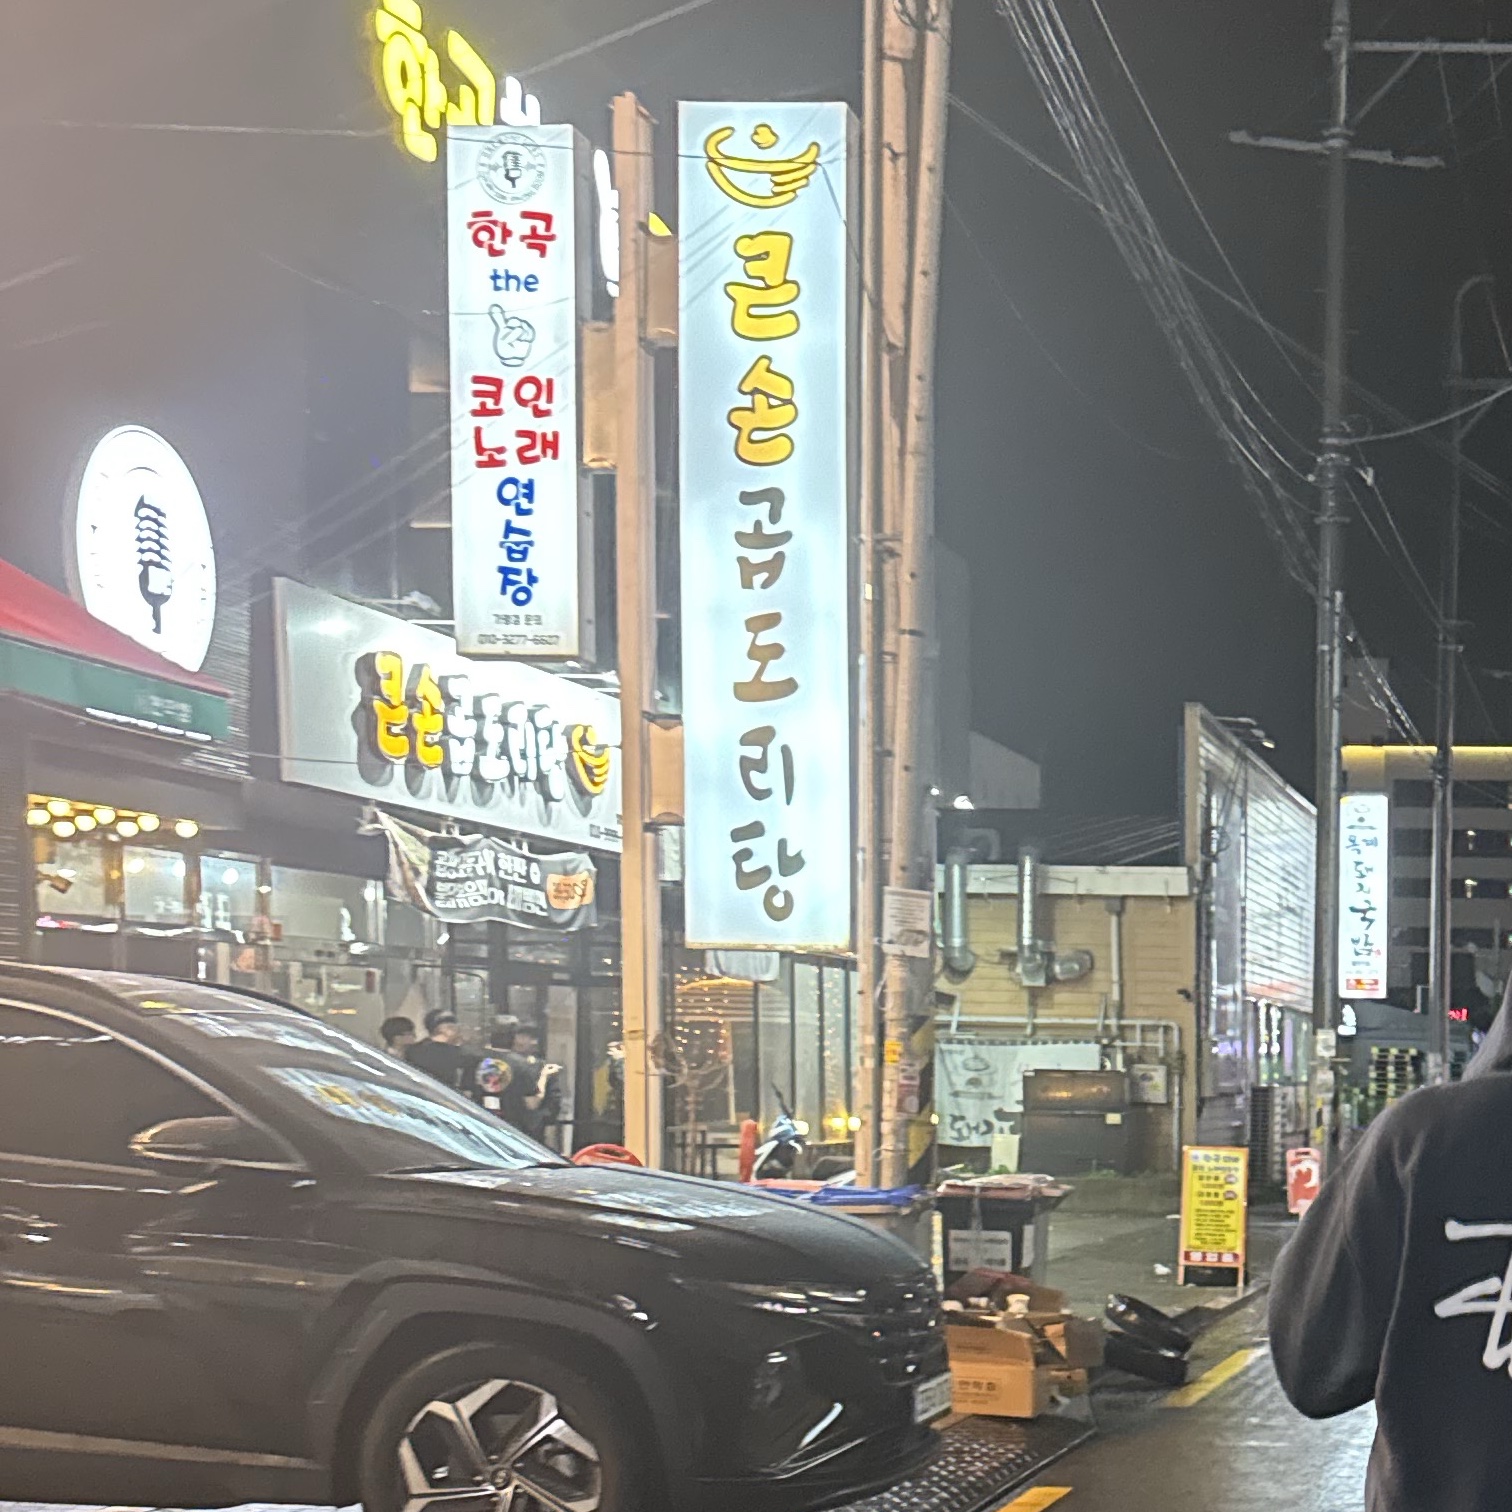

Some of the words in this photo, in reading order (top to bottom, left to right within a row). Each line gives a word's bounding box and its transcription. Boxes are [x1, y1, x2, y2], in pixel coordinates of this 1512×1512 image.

[466, 210, 557, 258] 한곡
[489, 268, 539, 292] the
[470, 375, 554, 418] 코인
[473, 425, 560, 468] 노래
[496, 476, 540, 607] 연습장
